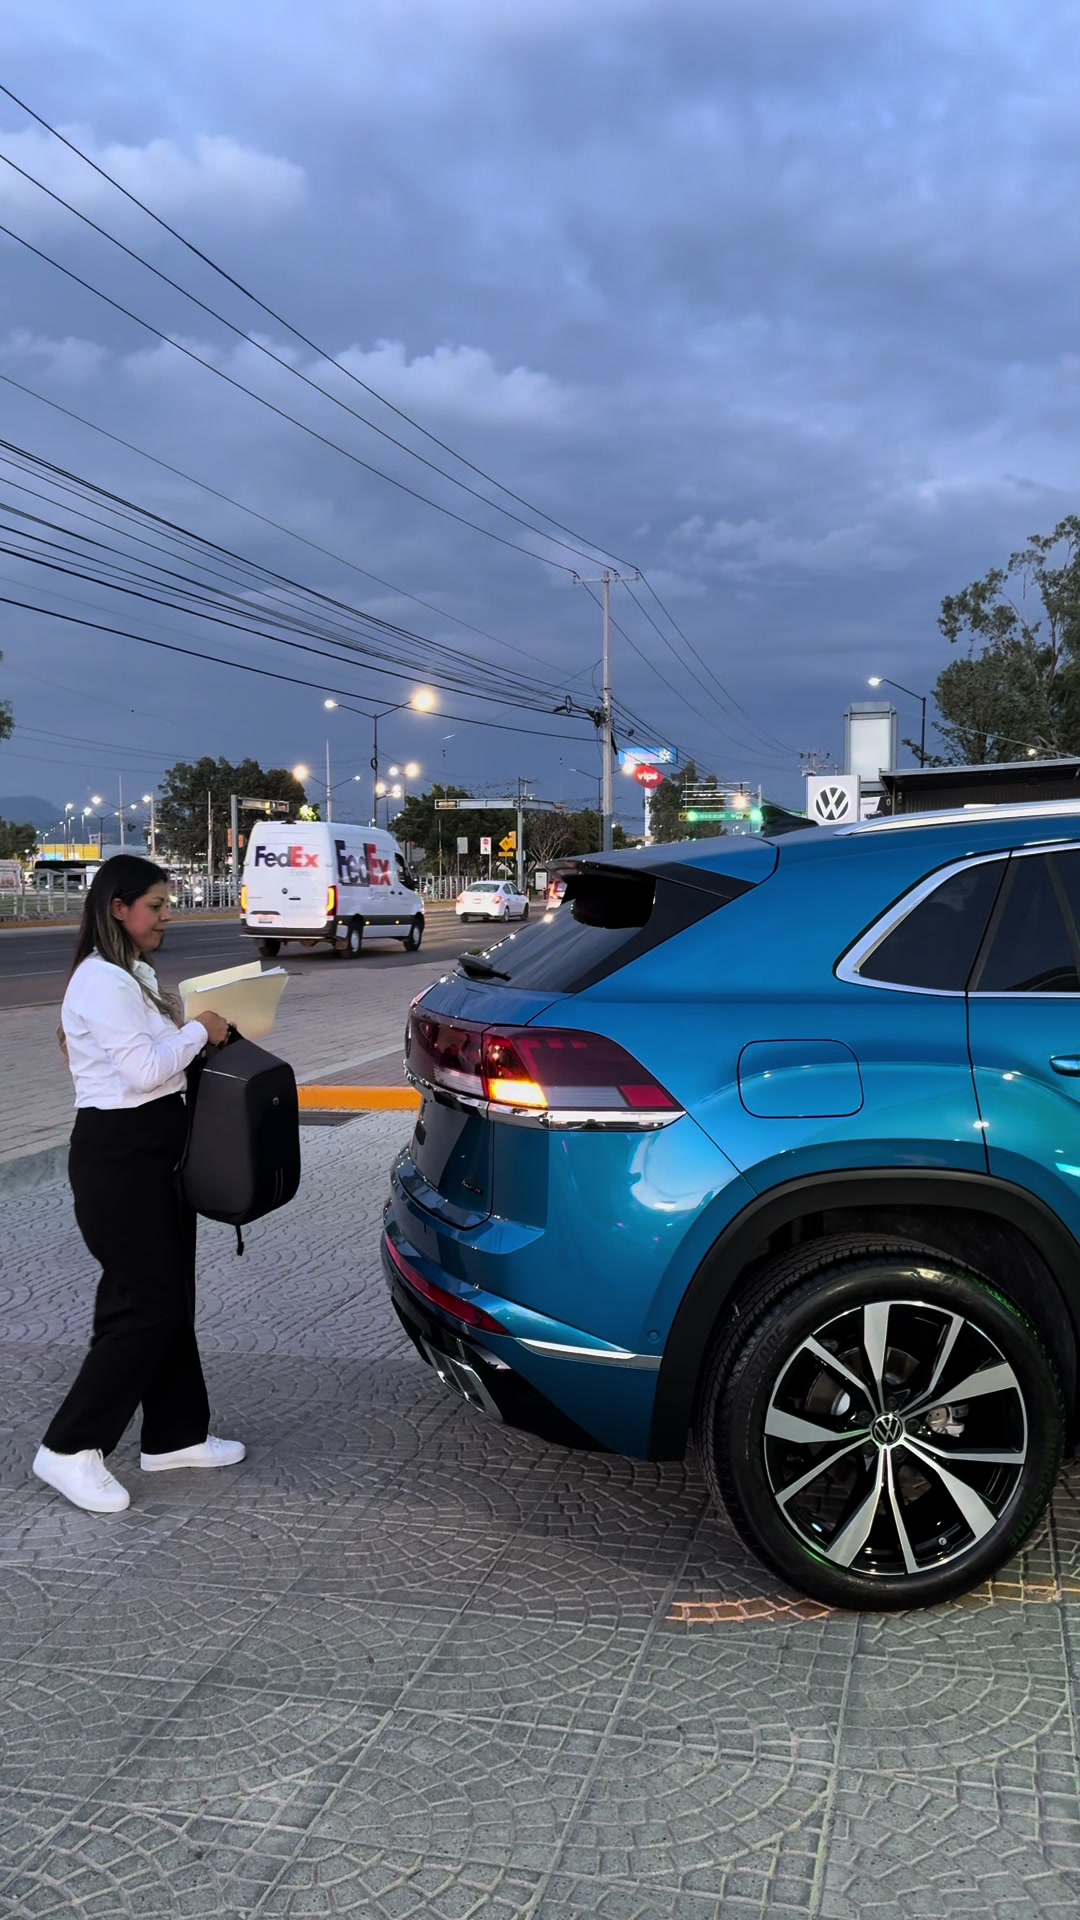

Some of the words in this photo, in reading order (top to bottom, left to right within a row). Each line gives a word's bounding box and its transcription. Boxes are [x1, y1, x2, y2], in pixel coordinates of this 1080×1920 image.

[637, 772, 658, 783] vips
[255, 845, 319, 868] FedEx
[335, 840, 392, 887] FedEx
